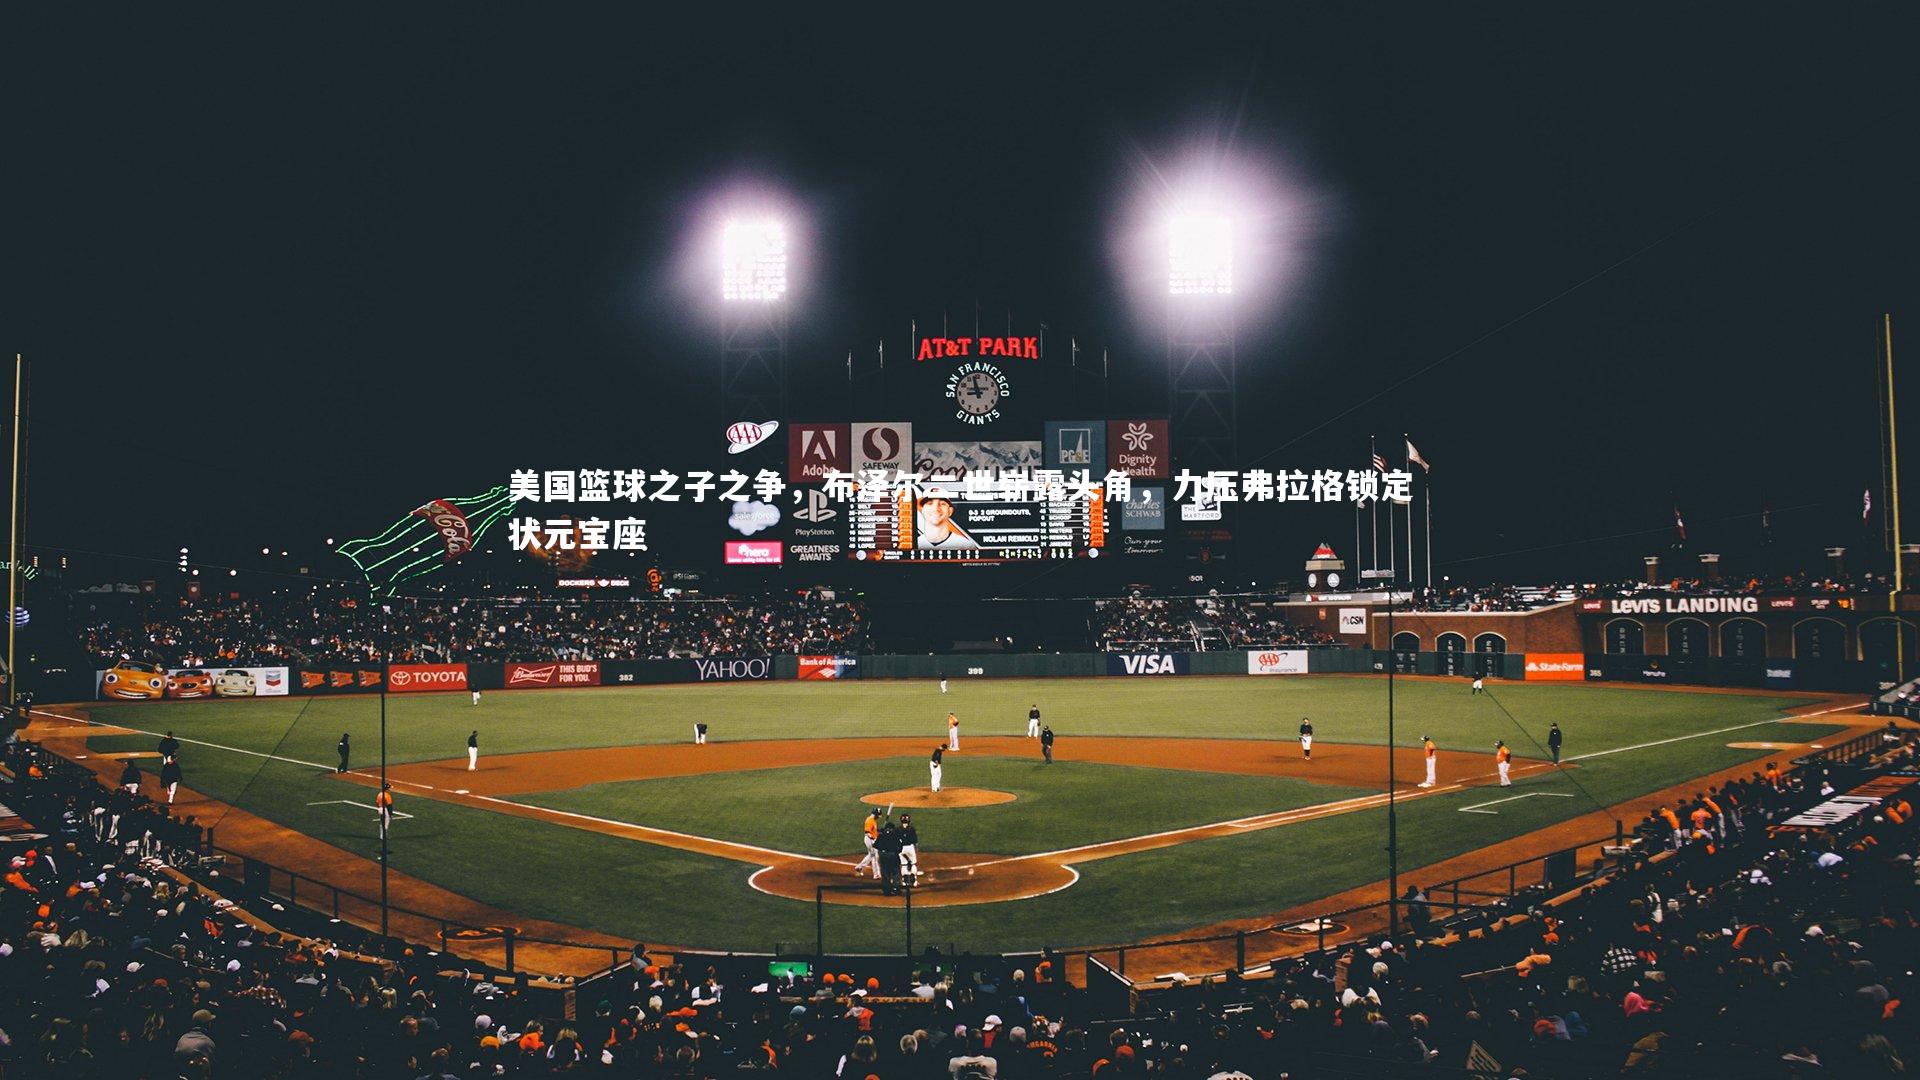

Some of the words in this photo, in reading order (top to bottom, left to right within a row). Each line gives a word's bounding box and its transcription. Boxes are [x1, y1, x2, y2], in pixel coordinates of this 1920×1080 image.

[917, 337, 972, 361] AT&T
[979, 336, 1038, 360] PARK
[945, 373, 960, 398] SAN
[958, 361, 1010, 397] FRANCISCO
[956, 409, 1001, 425] GIANTS
[1061, 449, 1089, 463] PG&E
[1119, 454, 1157, 467] Dignity
[862, 462, 899, 470] SAFEWAY
[1125, 510, 1161, 518] SCHWAB
[795, 528, 835, 538] PlayStation
[790, 545, 840, 553] GREATNESS
[799, 553, 832, 561] AWAITS
[1665, 597, 1758, 613] LANDING
[1349, 616, 1364, 625] CSN
[819, 658, 828, 666] of
[1119, 655, 1176, 674] VISA
[559, 665, 575, 673] THIS
[576, 664, 598, 673] BUD'S
[695, 658, 770, 680] YAHOO!
[413, 671, 466, 683] TOYOTA
[559, 674, 573, 683] FOR
[574, 674, 590, 683] YOU.
